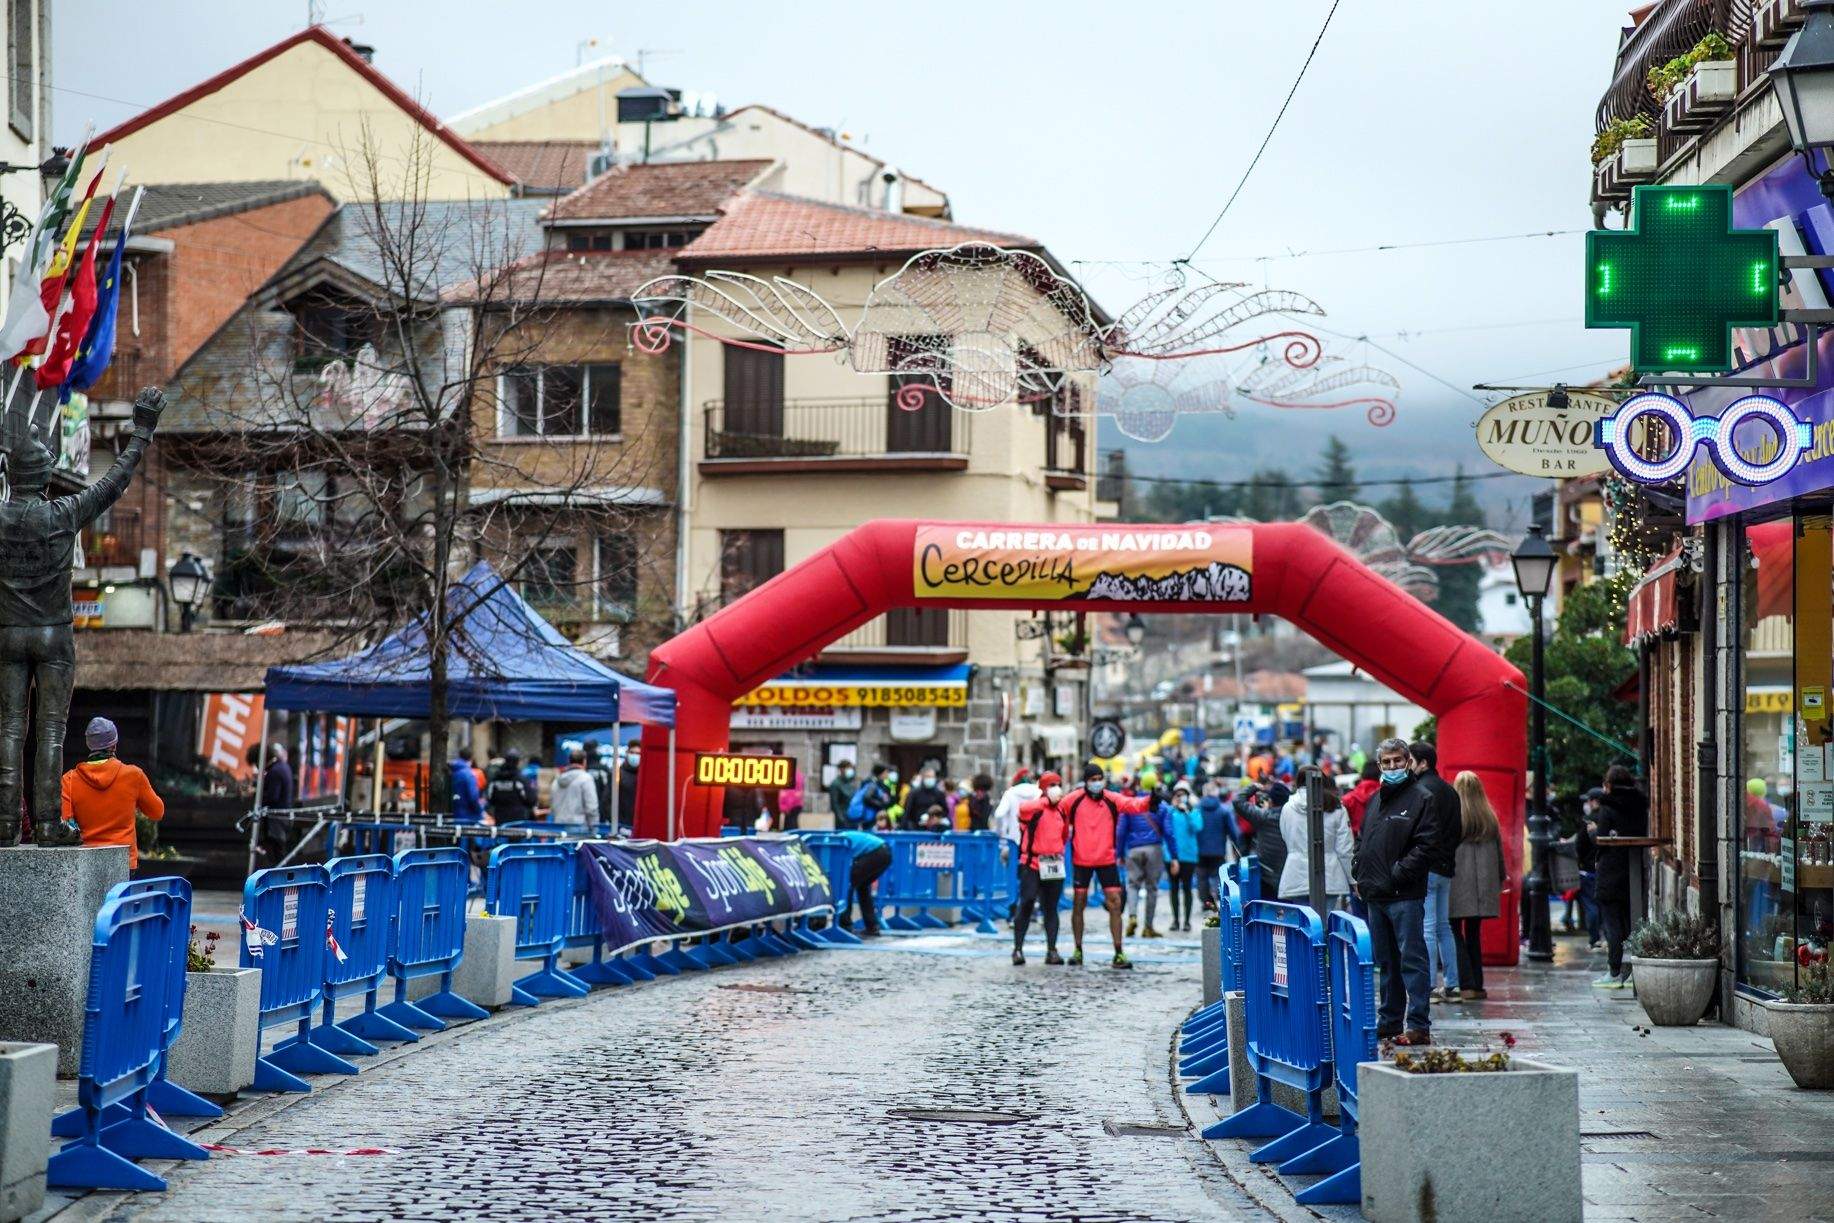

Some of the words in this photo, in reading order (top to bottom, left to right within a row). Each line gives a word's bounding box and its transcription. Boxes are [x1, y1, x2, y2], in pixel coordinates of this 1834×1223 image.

[1508, 398, 1612, 415] RESTRANTE
[1487, 413, 1595, 446] MUÑO
[1541, 458, 1576, 470] BAR
[956, 531, 1073, 550] CARRERA
[1101, 531, 1212, 551] NAVIDAD
[744, 687, 849, 701] OLDOS
[857, 687, 963, 701] 918508545
